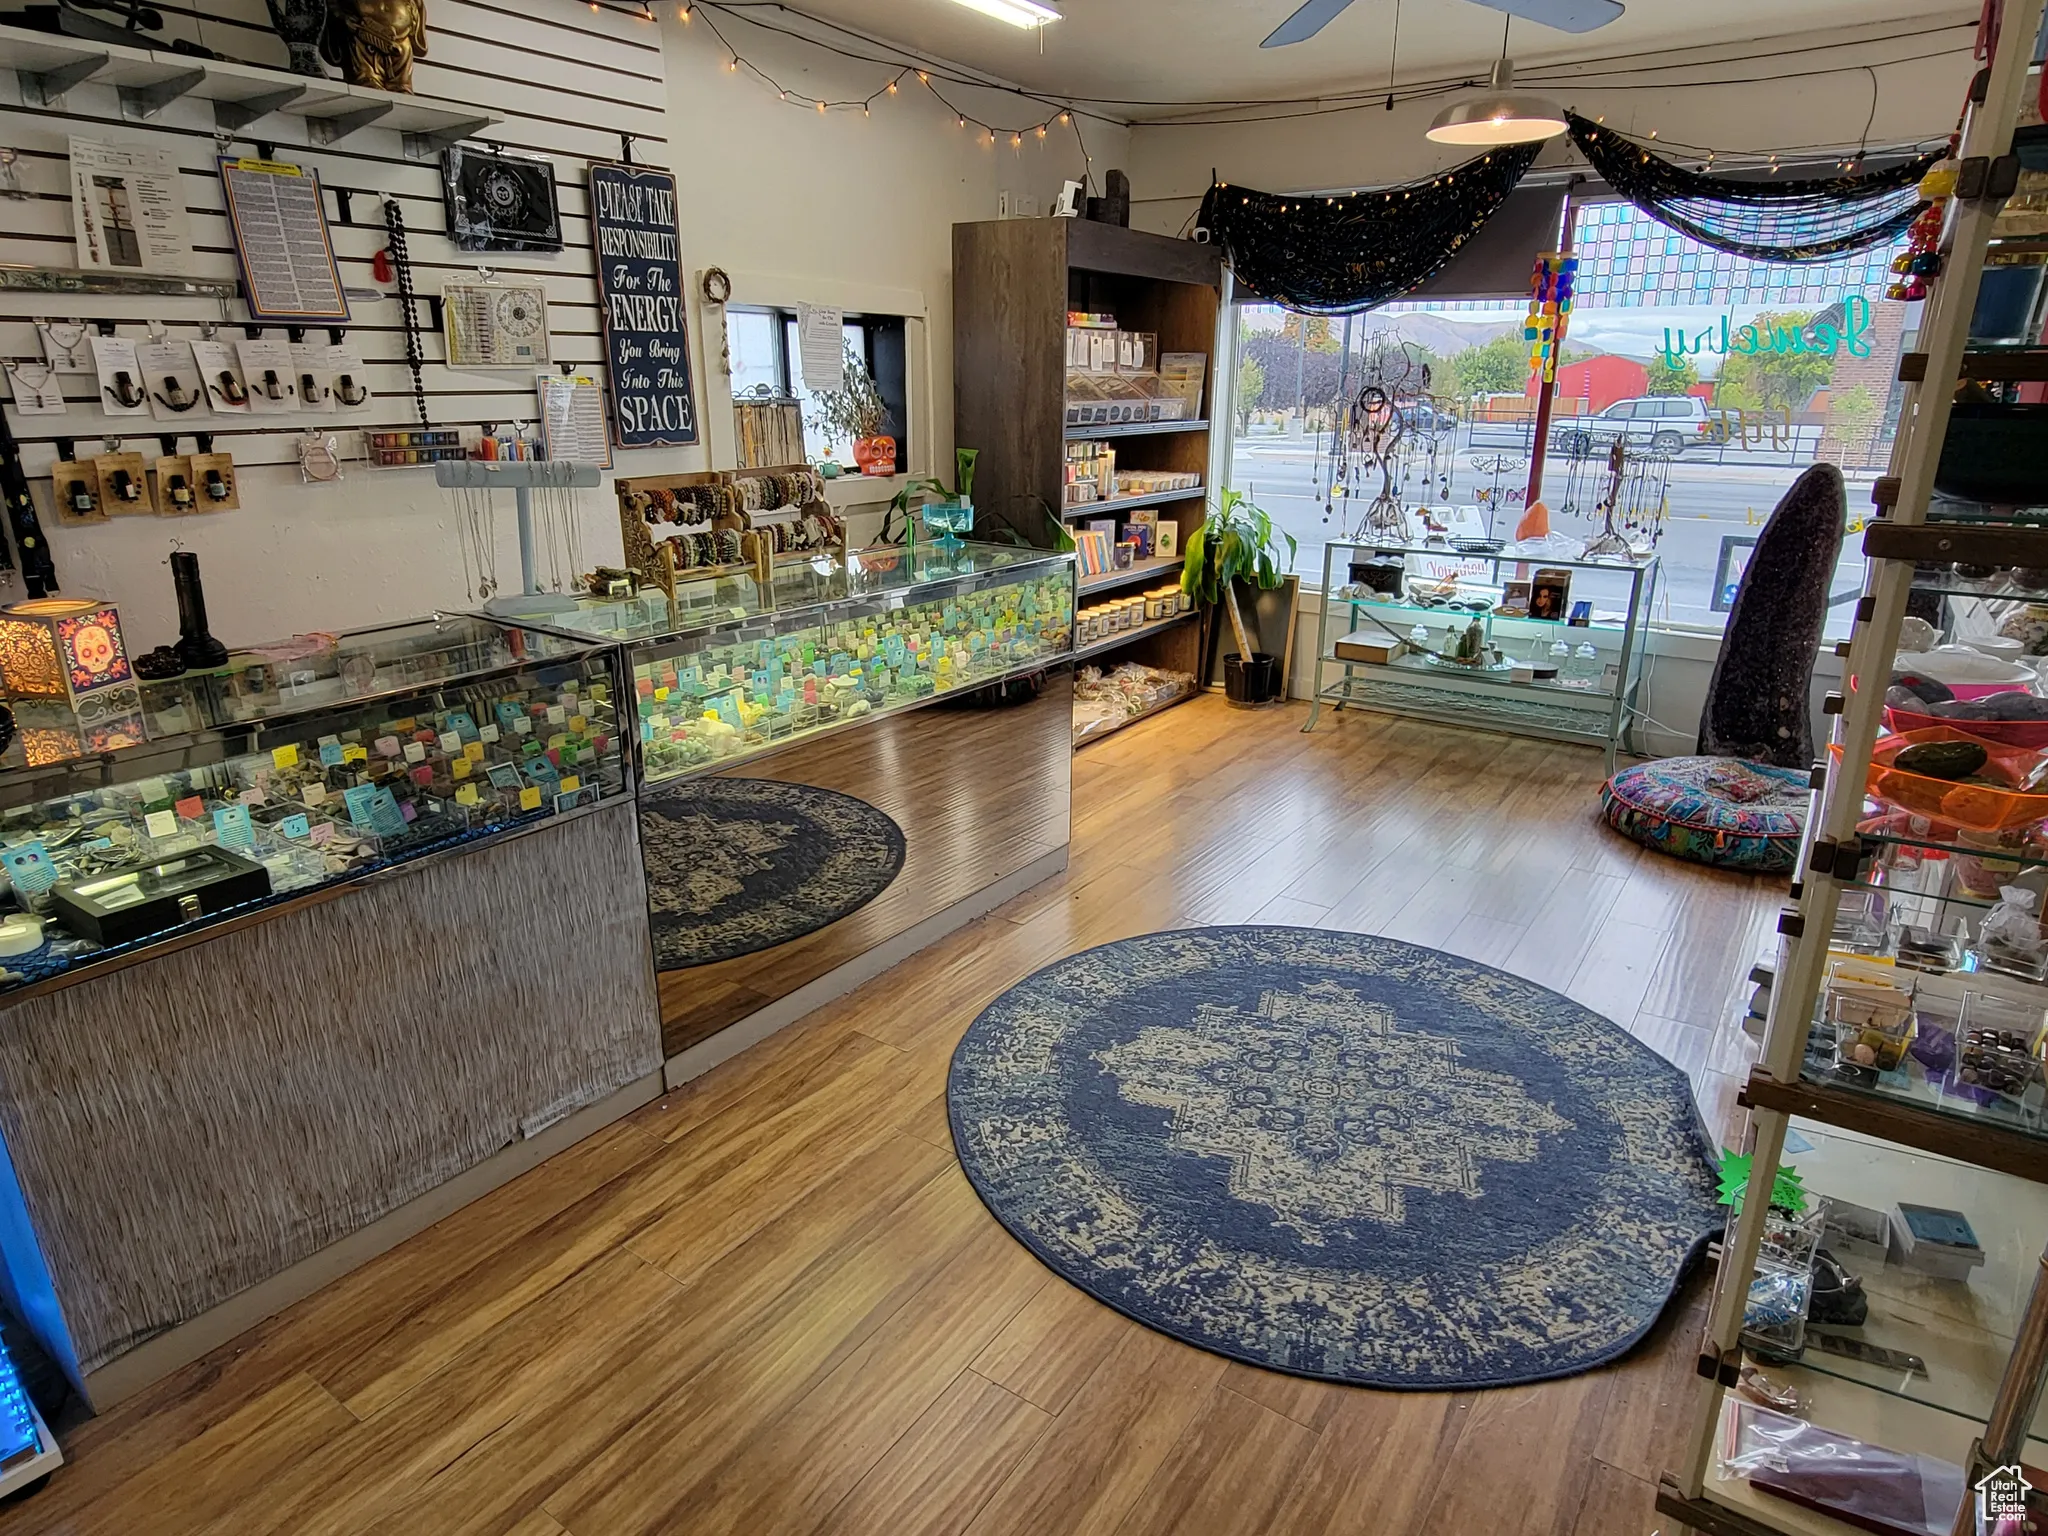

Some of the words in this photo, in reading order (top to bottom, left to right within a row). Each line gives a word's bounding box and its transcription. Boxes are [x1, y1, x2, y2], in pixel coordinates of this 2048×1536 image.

[597, 180, 645, 226] PLEASE
[645, 186, 675, 227] TAKE
[600, 226, 677, 261] RESPONSIBILITY
[613, 264, 640, 289] For
[647, 267, 672, 292] The
[610, 293, 679, 333] ENERGY
[619, 338, 642, 365] You
[649, 338, 680, 365] Bring
[621, 368, 650, 389] Into
[657, 368, 684, 389] This
[620, 393, 692, 434] SPACE
